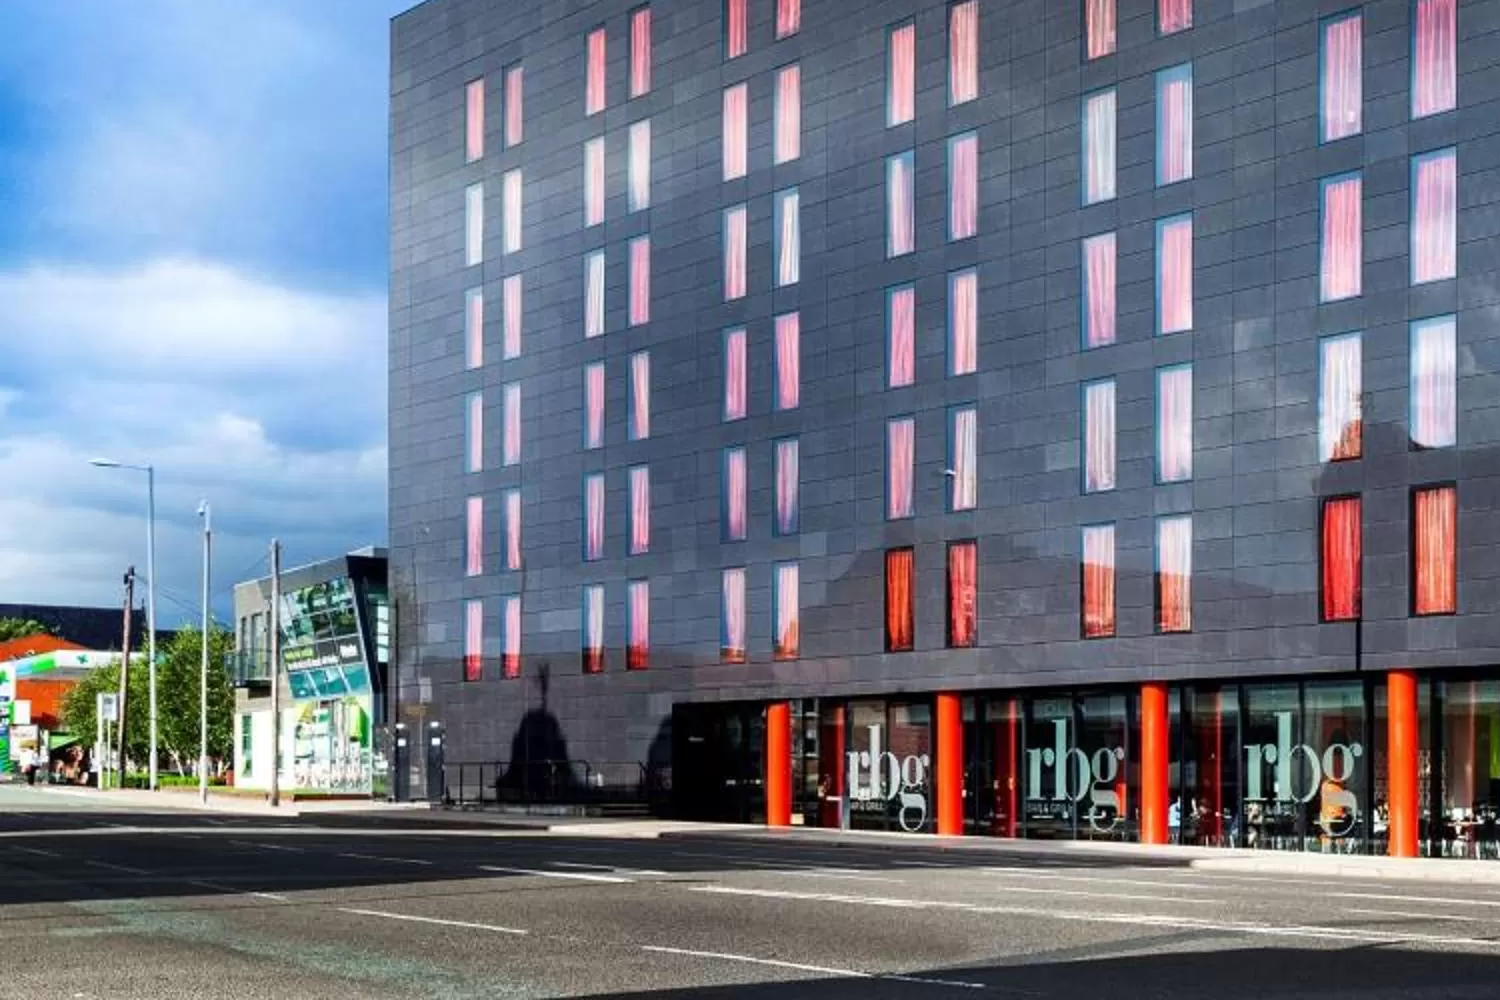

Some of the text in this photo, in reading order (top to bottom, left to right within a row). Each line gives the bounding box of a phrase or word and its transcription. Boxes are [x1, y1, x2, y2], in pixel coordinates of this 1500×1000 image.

[846, 723, 930, 832] rbg
[1026, 719, 1124, 833] rbg
[1243, 711, 1362, 837] rbg
